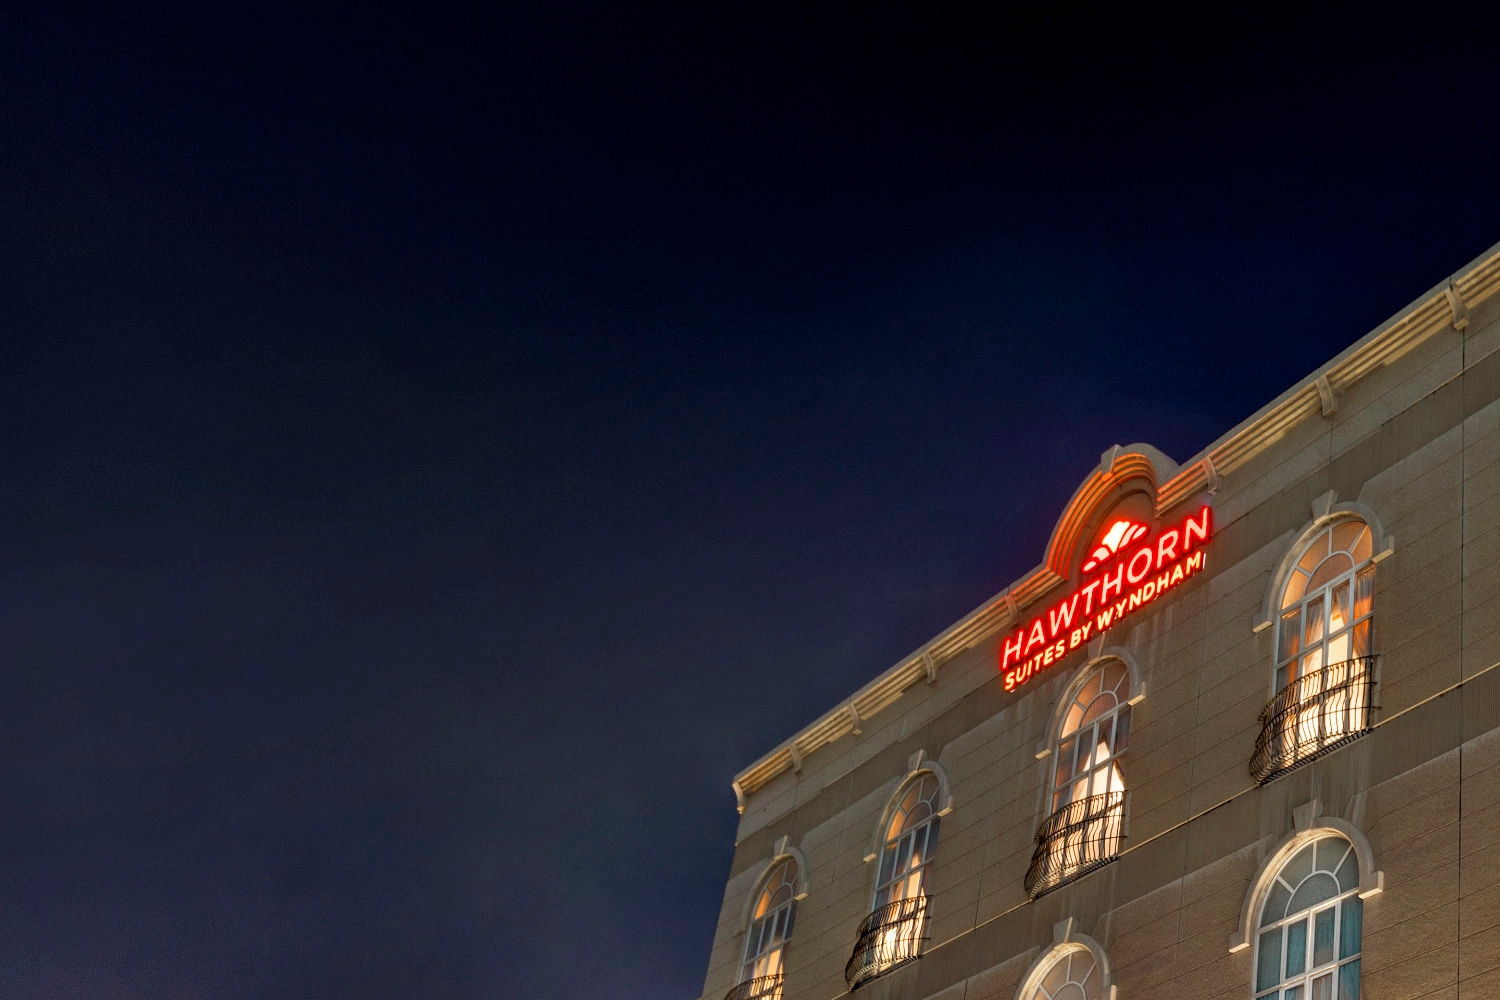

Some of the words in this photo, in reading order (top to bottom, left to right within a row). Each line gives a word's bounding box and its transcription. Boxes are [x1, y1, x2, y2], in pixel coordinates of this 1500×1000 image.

[1001, 506, 1211, 669] HAWTHORN
[1004, 639, 1066, 691] SUITES
[1069, 620, 1093, 650] BY
[1097, 551, 1203, 632] WYNDHAM
